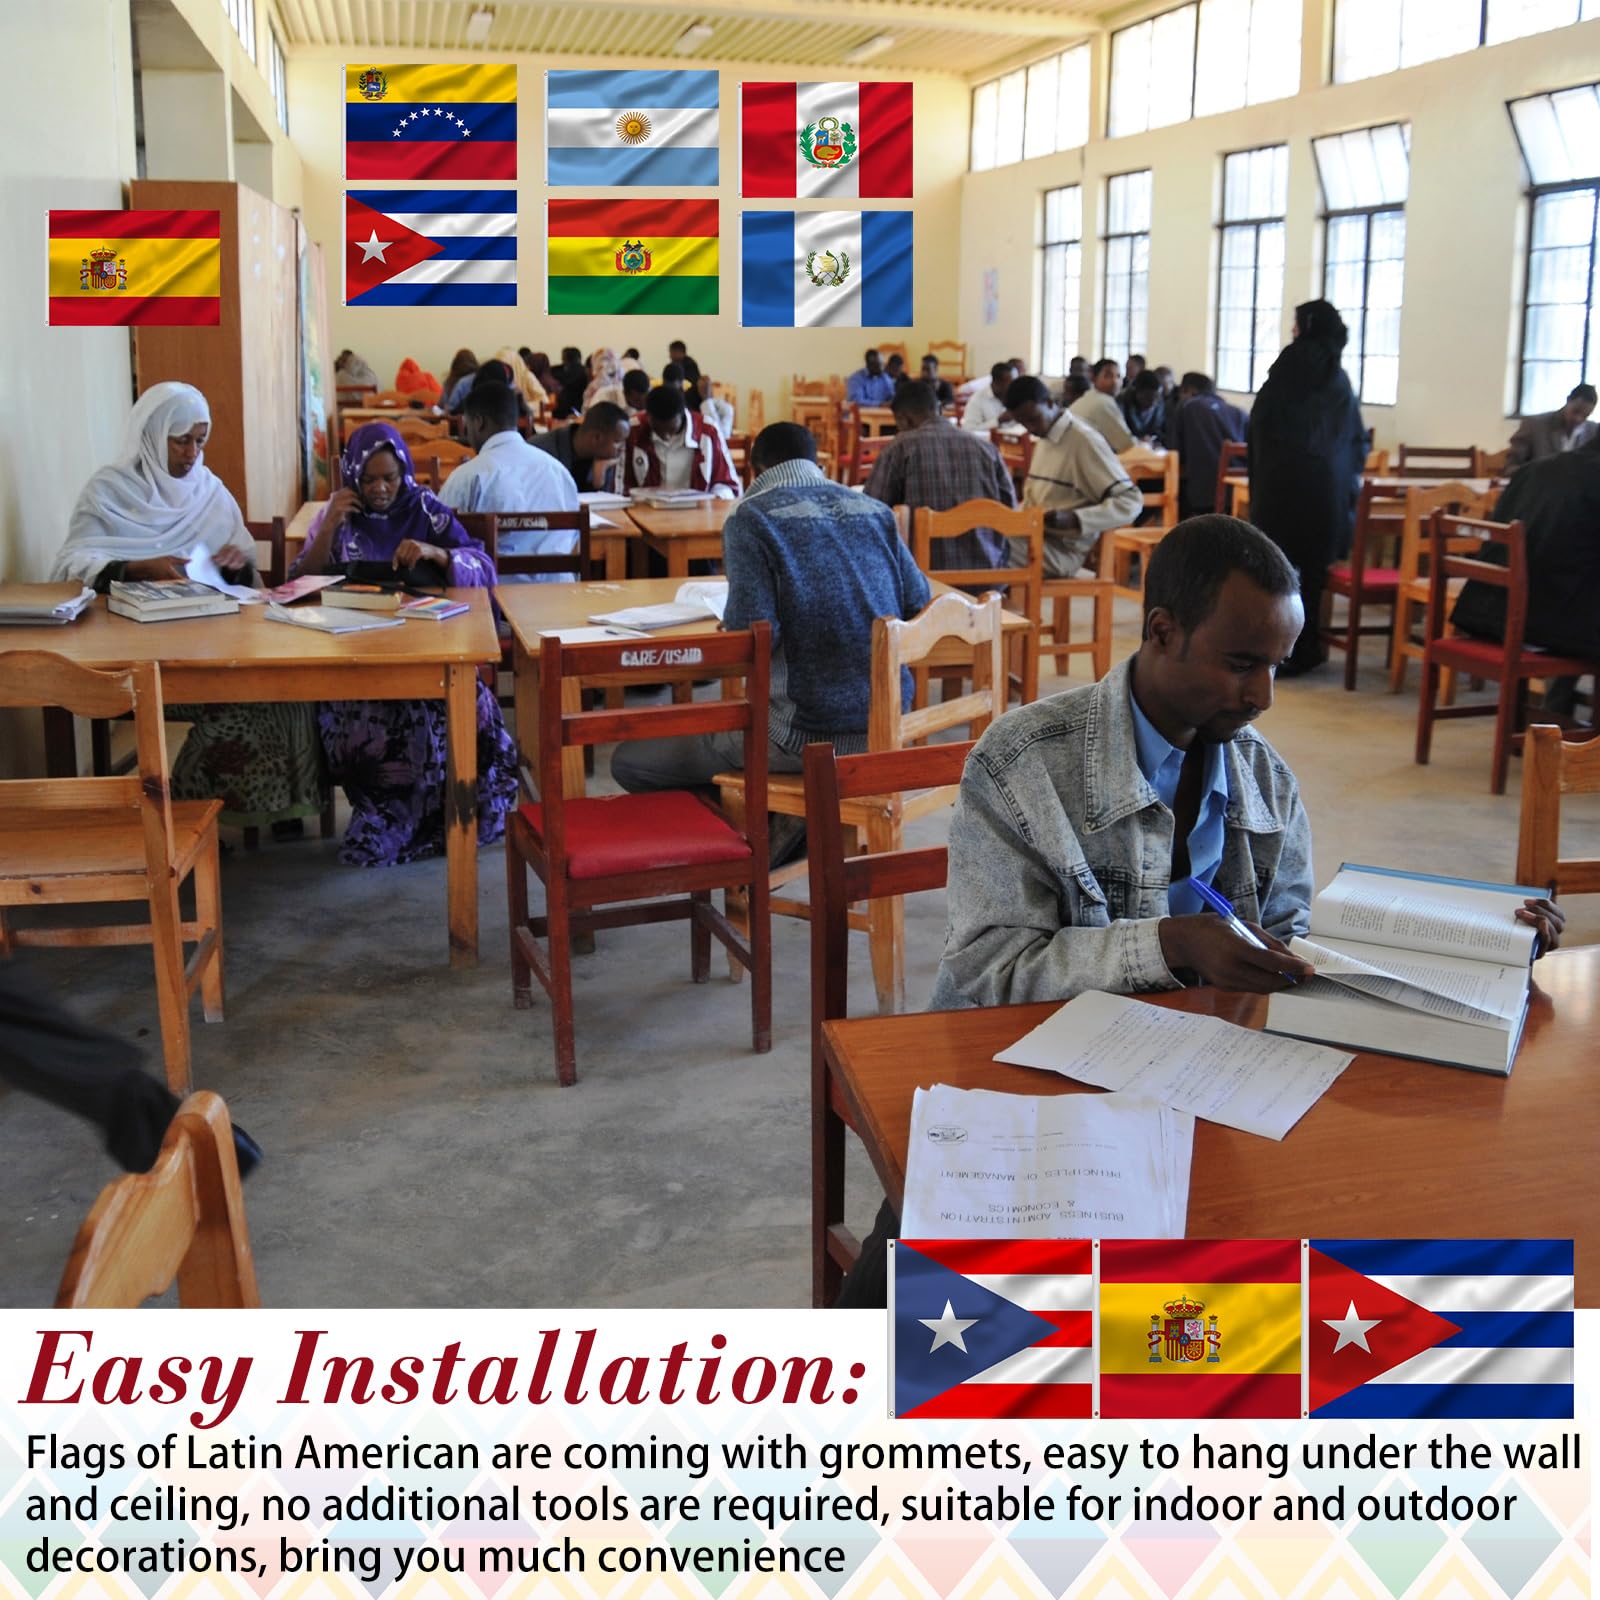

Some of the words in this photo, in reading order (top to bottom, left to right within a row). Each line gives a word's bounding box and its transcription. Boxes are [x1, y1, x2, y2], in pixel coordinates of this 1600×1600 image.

[621, 647, 704, 667] CARE/USAID
[987, 1201, 1060, 1214] ECONOMICS
[940, 1212, 1052, 1225] ADMINISTRATION
[1059, 1210, 1125, 1222] BUSINESS
